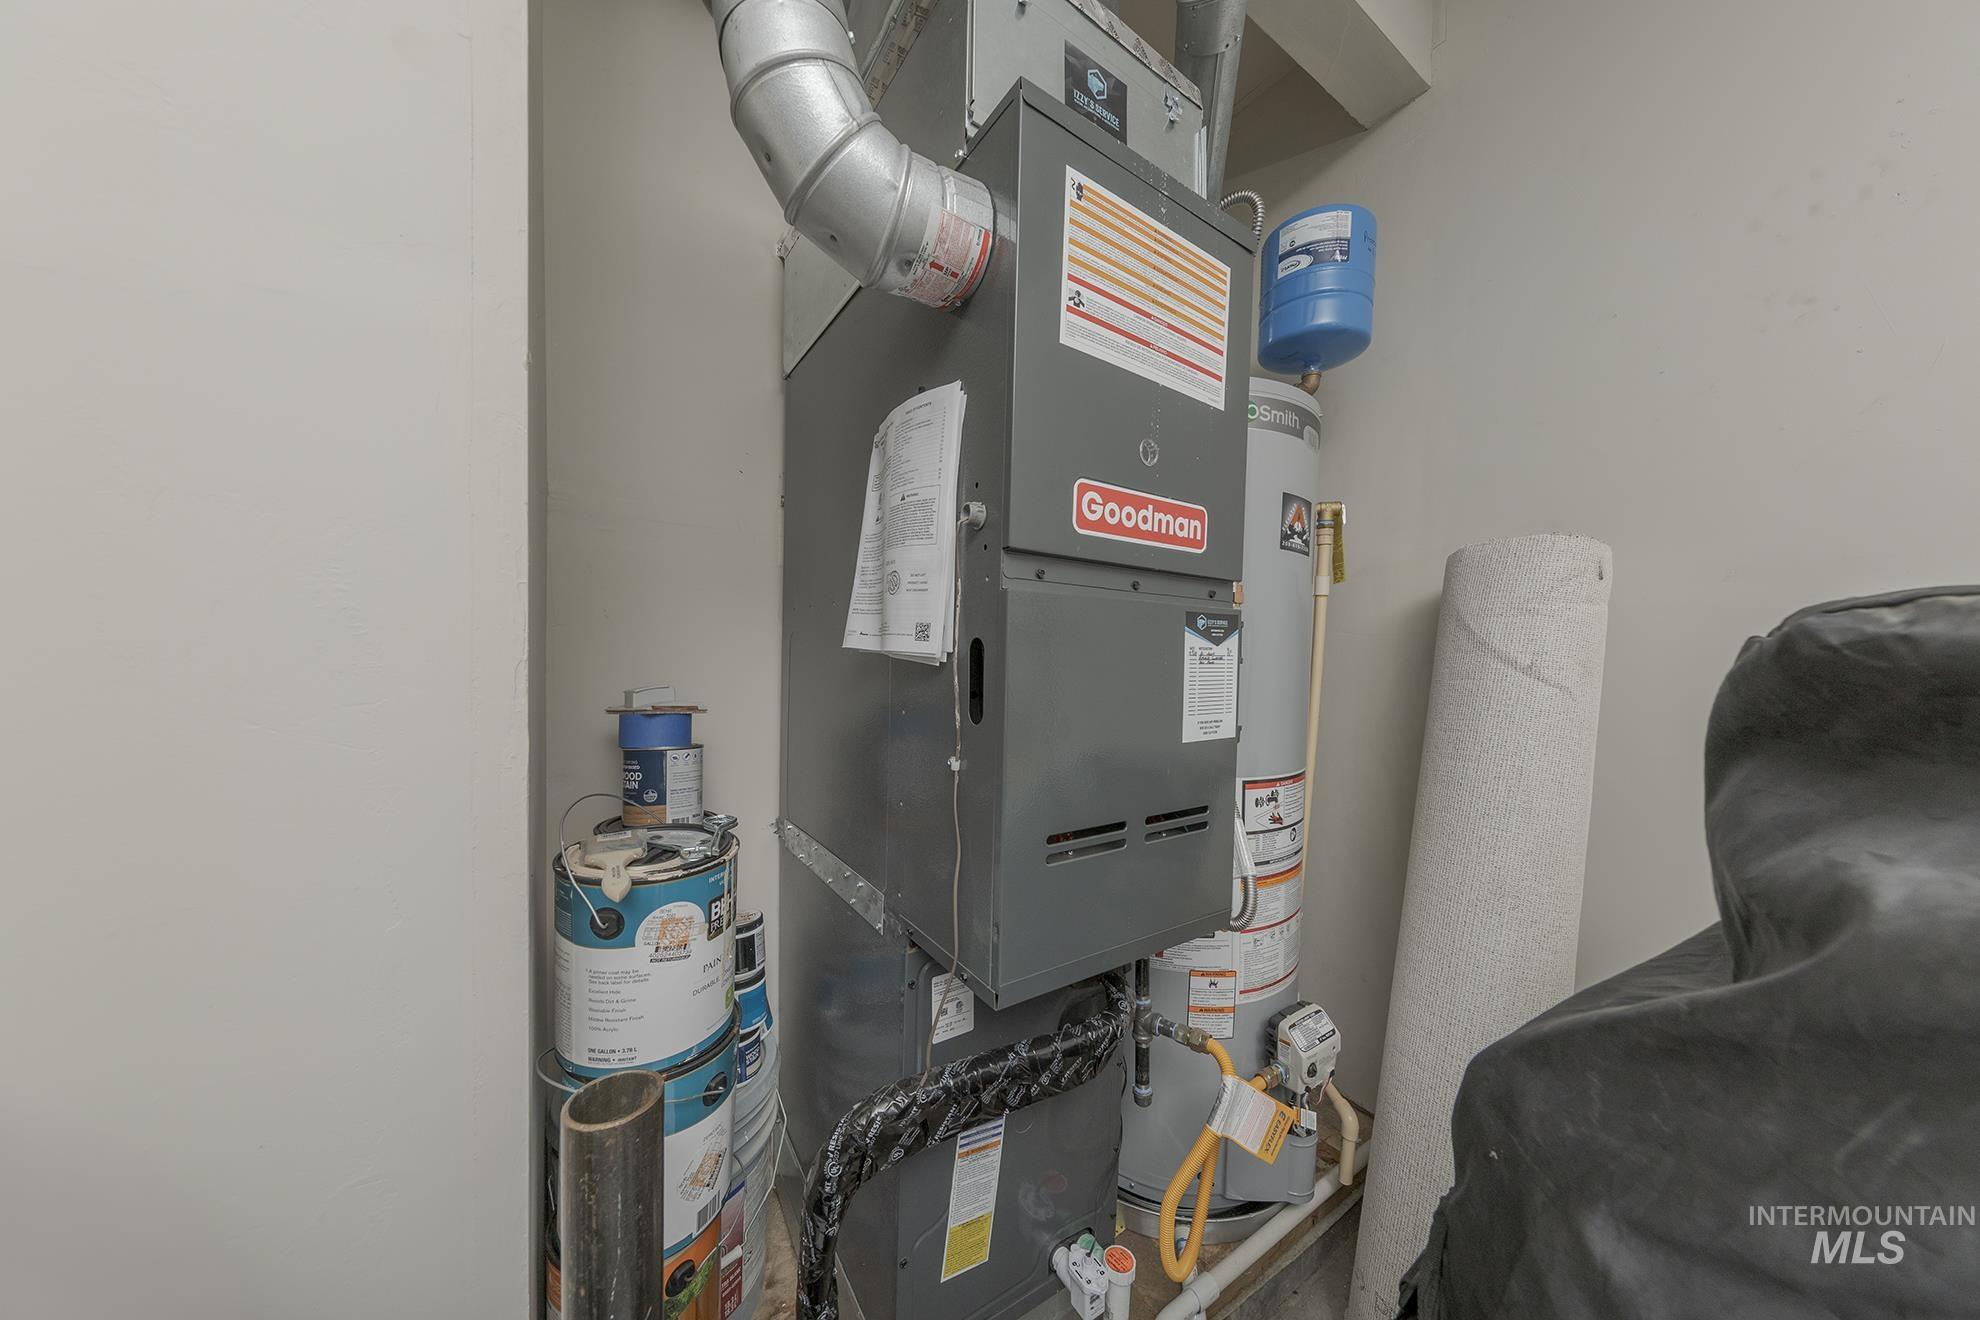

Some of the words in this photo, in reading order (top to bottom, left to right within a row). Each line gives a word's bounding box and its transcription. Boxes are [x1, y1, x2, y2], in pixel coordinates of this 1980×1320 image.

[1073, 88, 1095, 110] IZZY'S
[1095, 103, 1120, 128] SERVICE
[1081, 490, 1202, 540] Goodman
[624, 772, 642, 781] OOD
